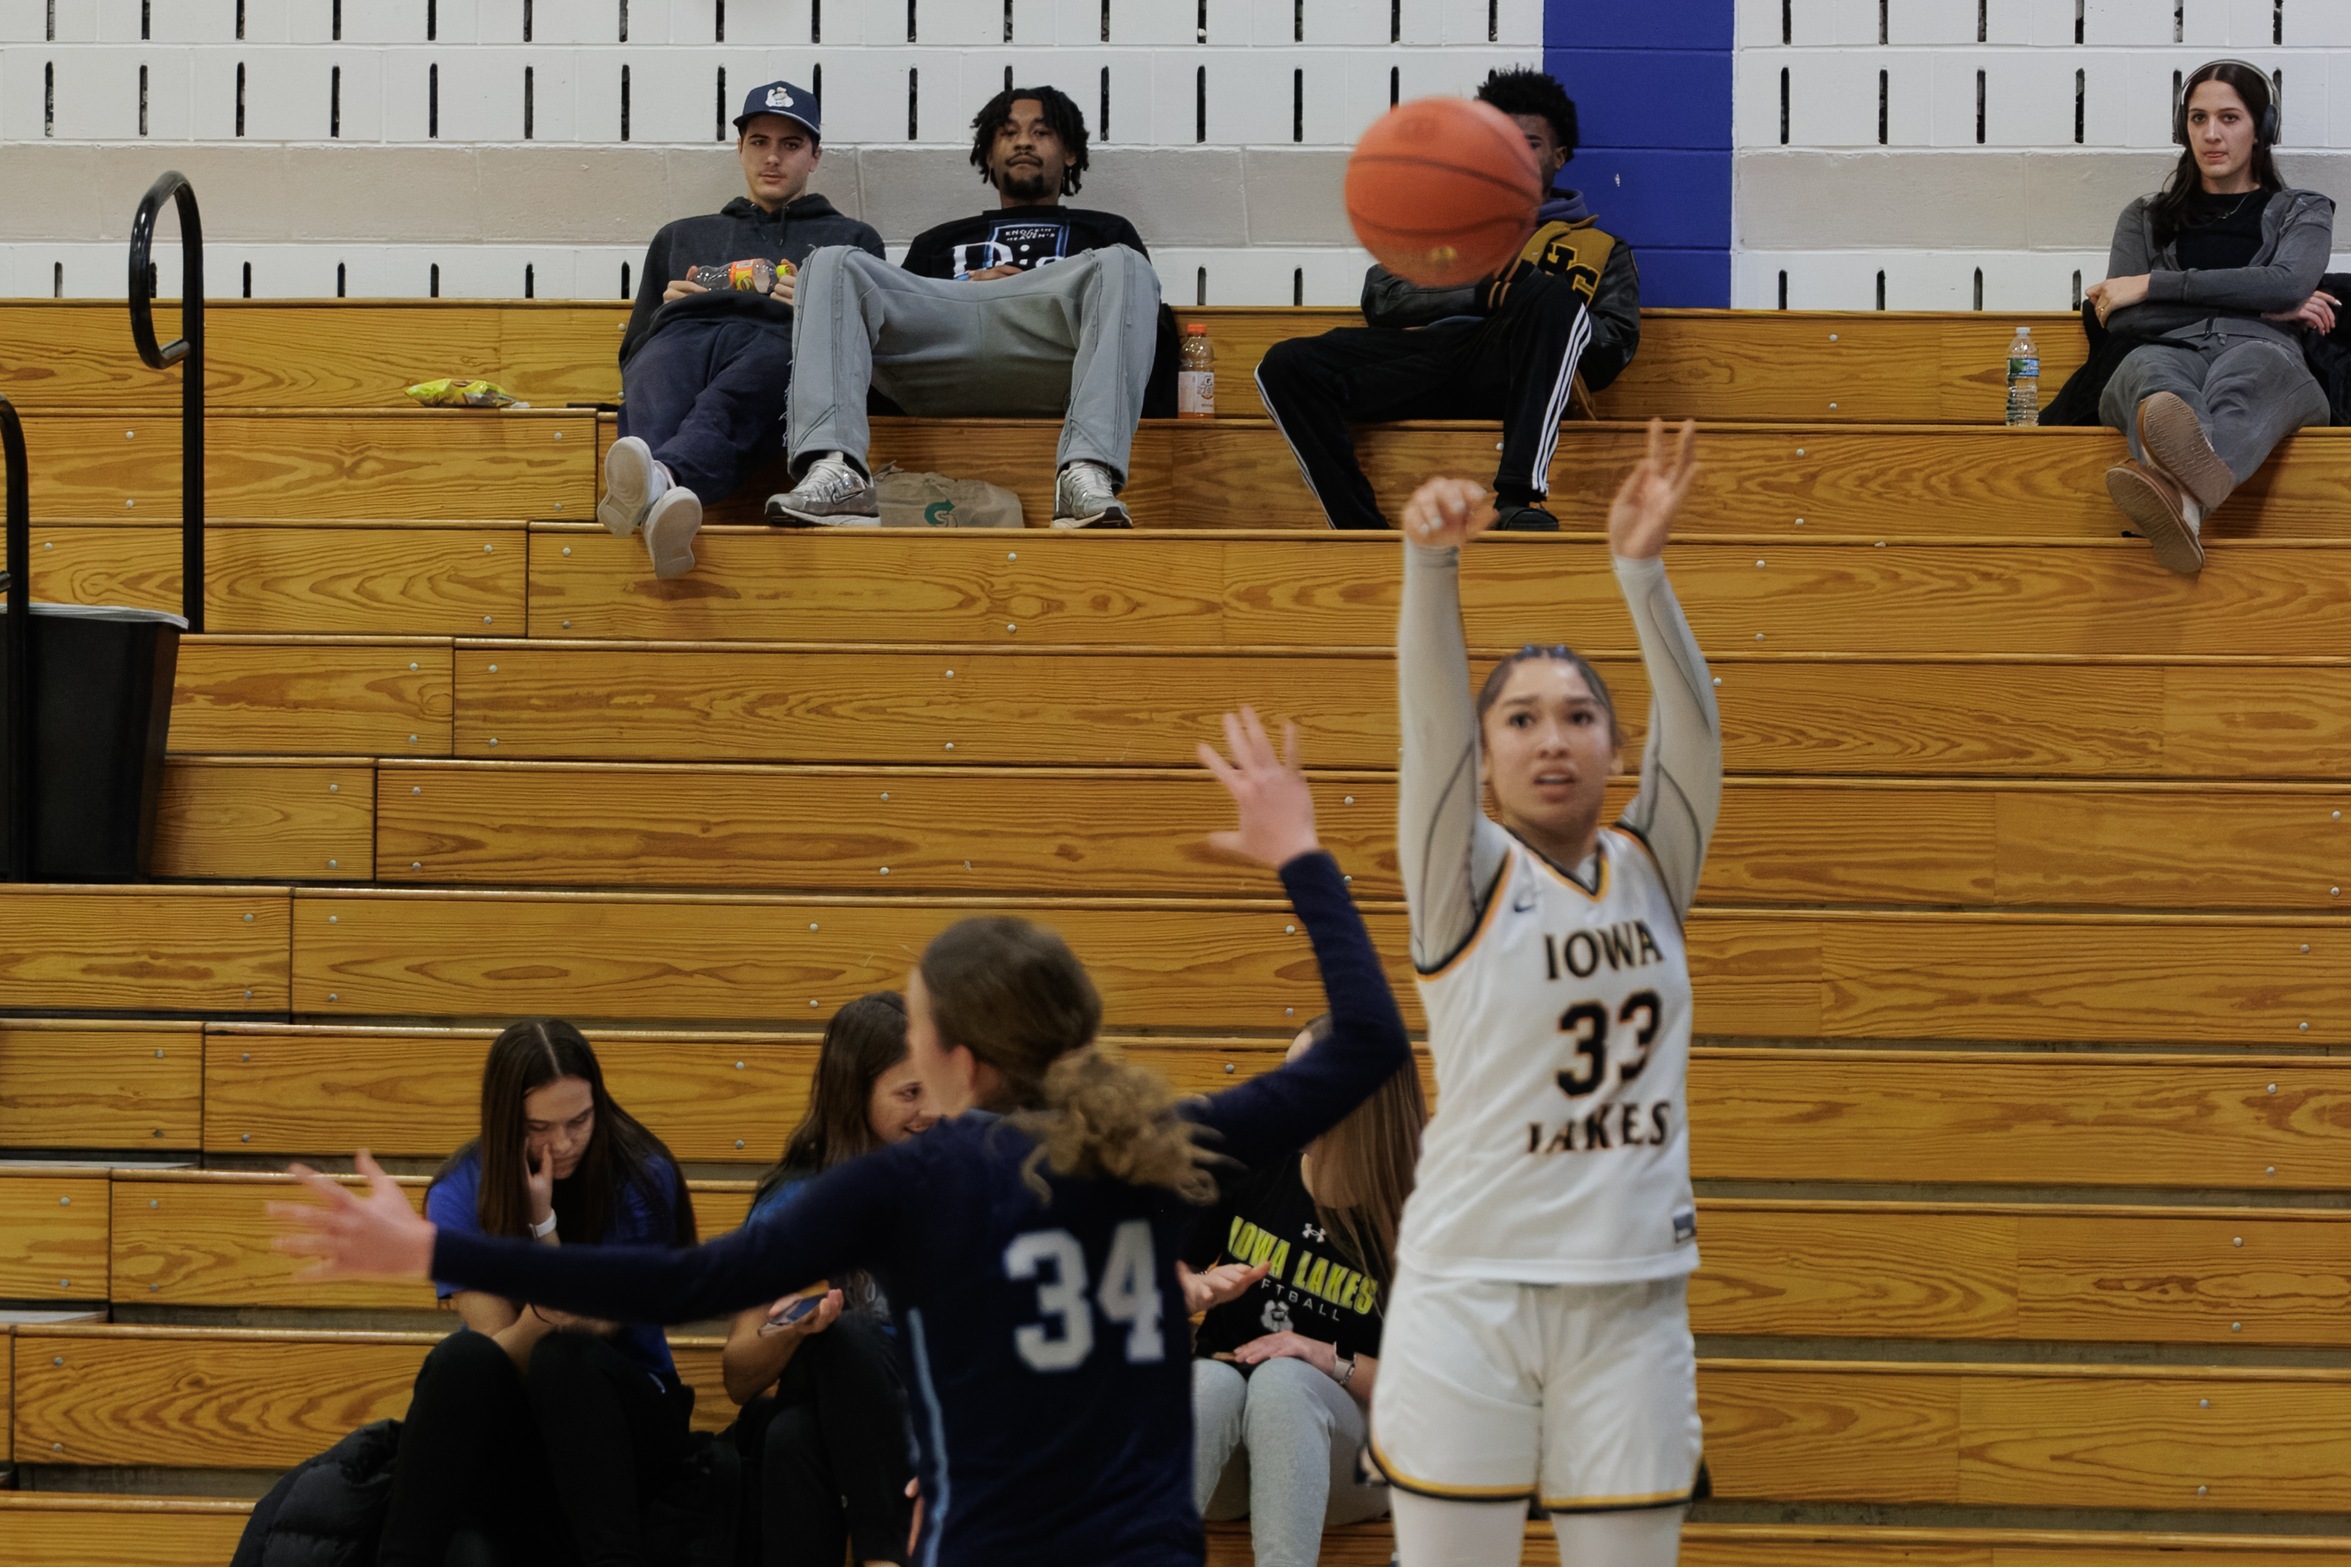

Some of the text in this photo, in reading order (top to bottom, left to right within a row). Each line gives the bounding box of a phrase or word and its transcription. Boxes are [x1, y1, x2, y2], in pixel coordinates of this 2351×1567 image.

[1544, 919, 1666, 981] IOWA
[1556, 988, 1663, 1099] 33
[1003, 1218, 1165, 1372] 34
[1227, 1215, 1378, 1315] IOWA LAKES
[1260, 1277, 1340, 1322] FTBALL
